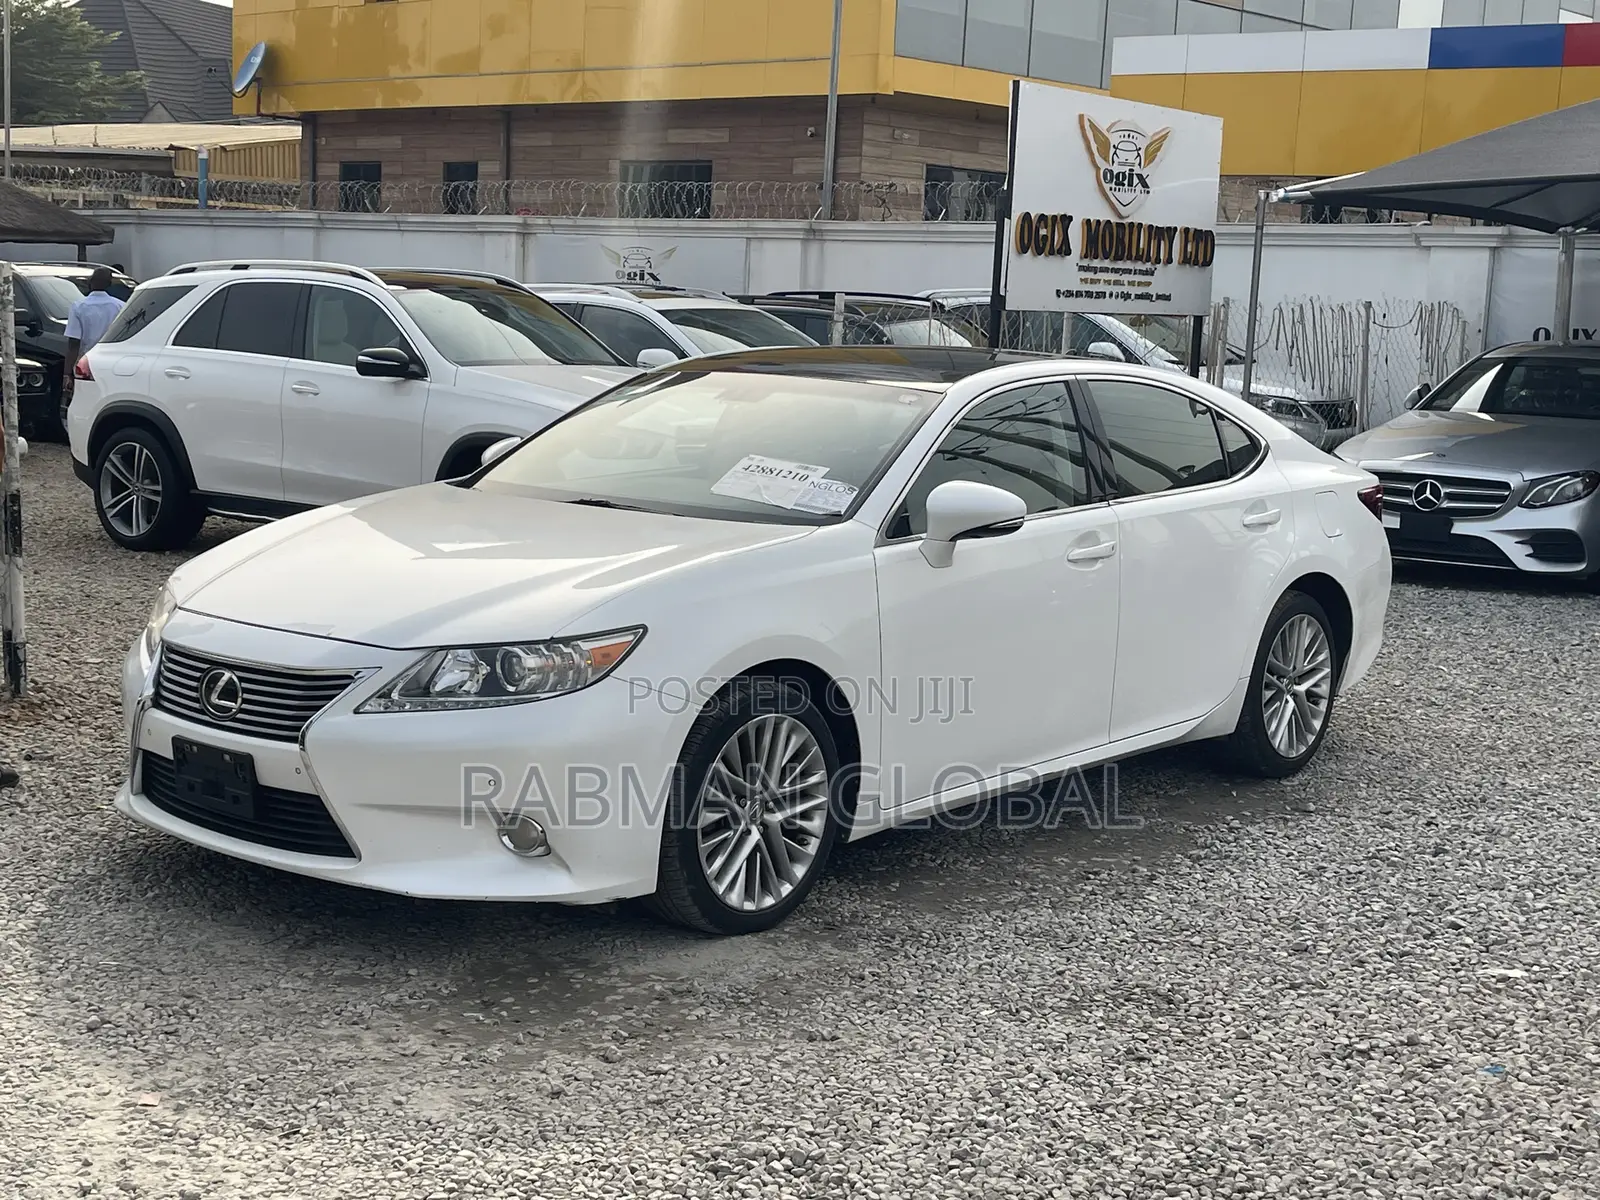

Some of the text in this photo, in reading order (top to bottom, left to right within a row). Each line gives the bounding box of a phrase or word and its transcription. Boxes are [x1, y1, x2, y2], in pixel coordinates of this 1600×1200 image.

[1015, 211, 1216, 267] OGIX MOBILITY LTD
[742, 464, 810, 482] 42881210
[808, 480, 858, 495] NGLOS
